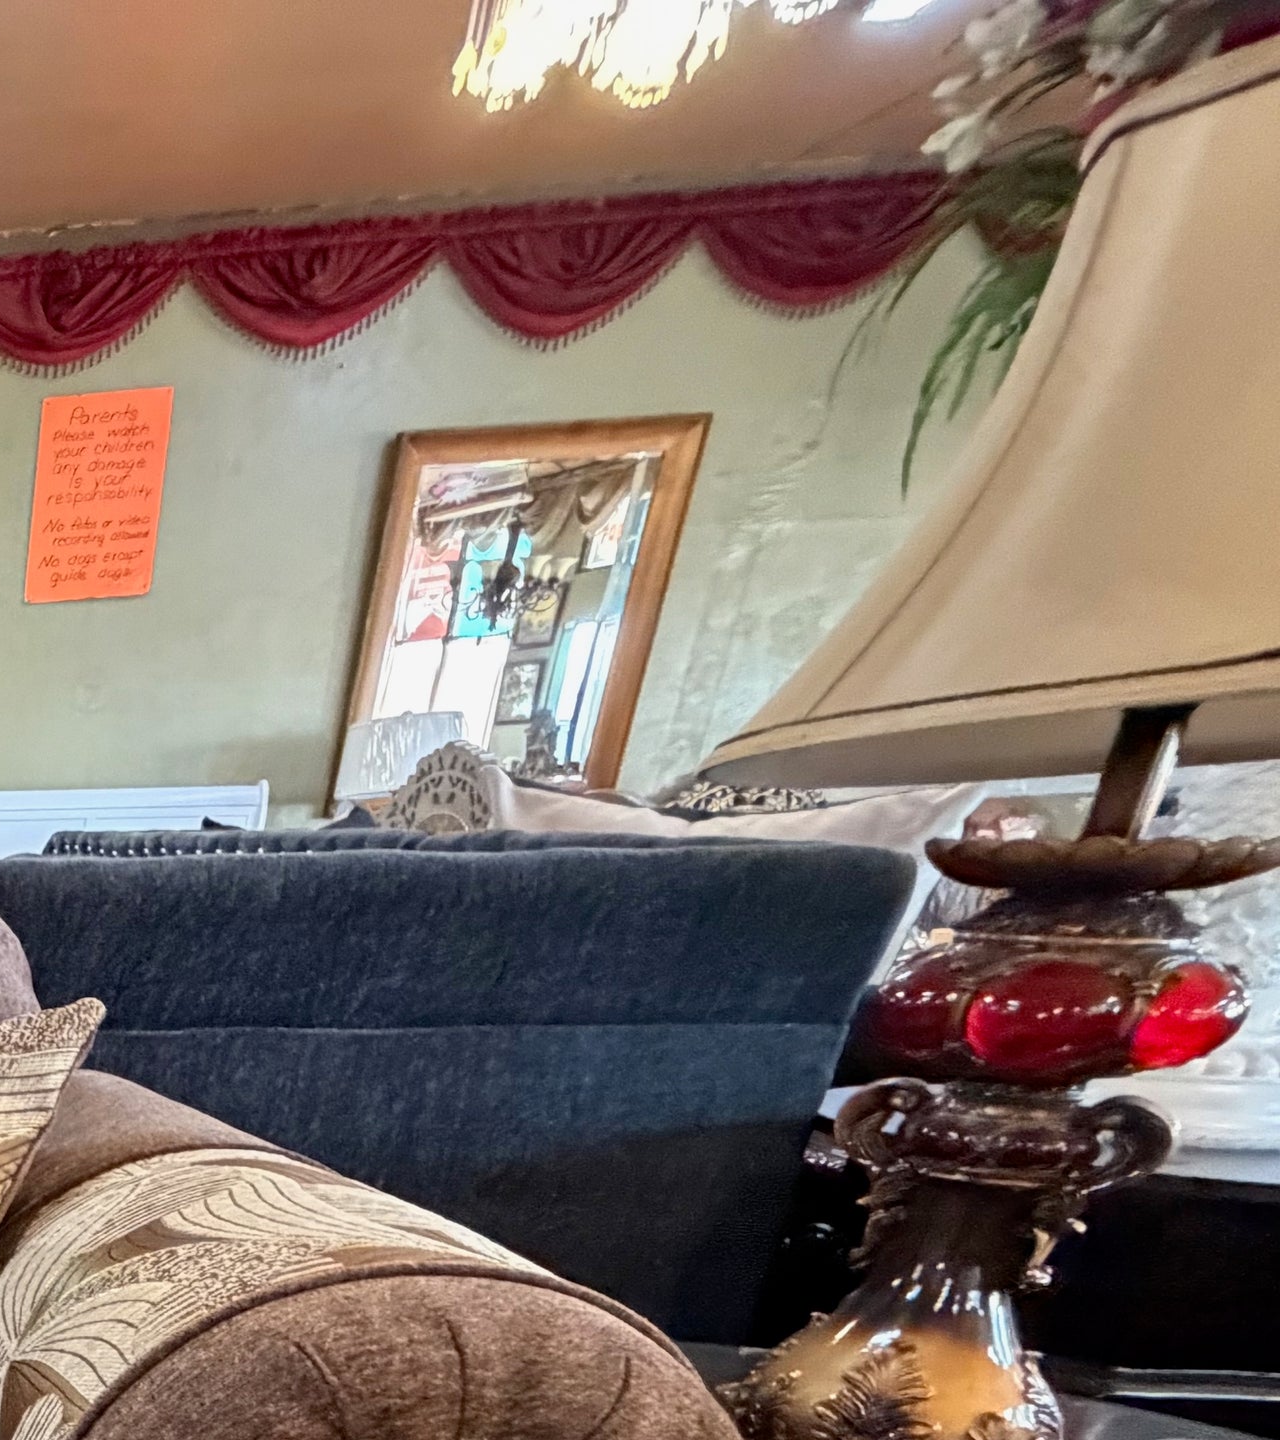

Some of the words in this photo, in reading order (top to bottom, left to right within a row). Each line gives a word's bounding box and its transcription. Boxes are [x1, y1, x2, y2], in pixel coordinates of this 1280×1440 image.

[69, 403, 138, 425] Parents
[54, 446, 87, 463] your
[93, 439, 155, 455] children
[52, 463, 80, 477] any
[87, 458, 146, 474] damage
[95, 474, 131, 490] your
[42, 518, 65, 533] No
[37, 554, 60, 569] No
